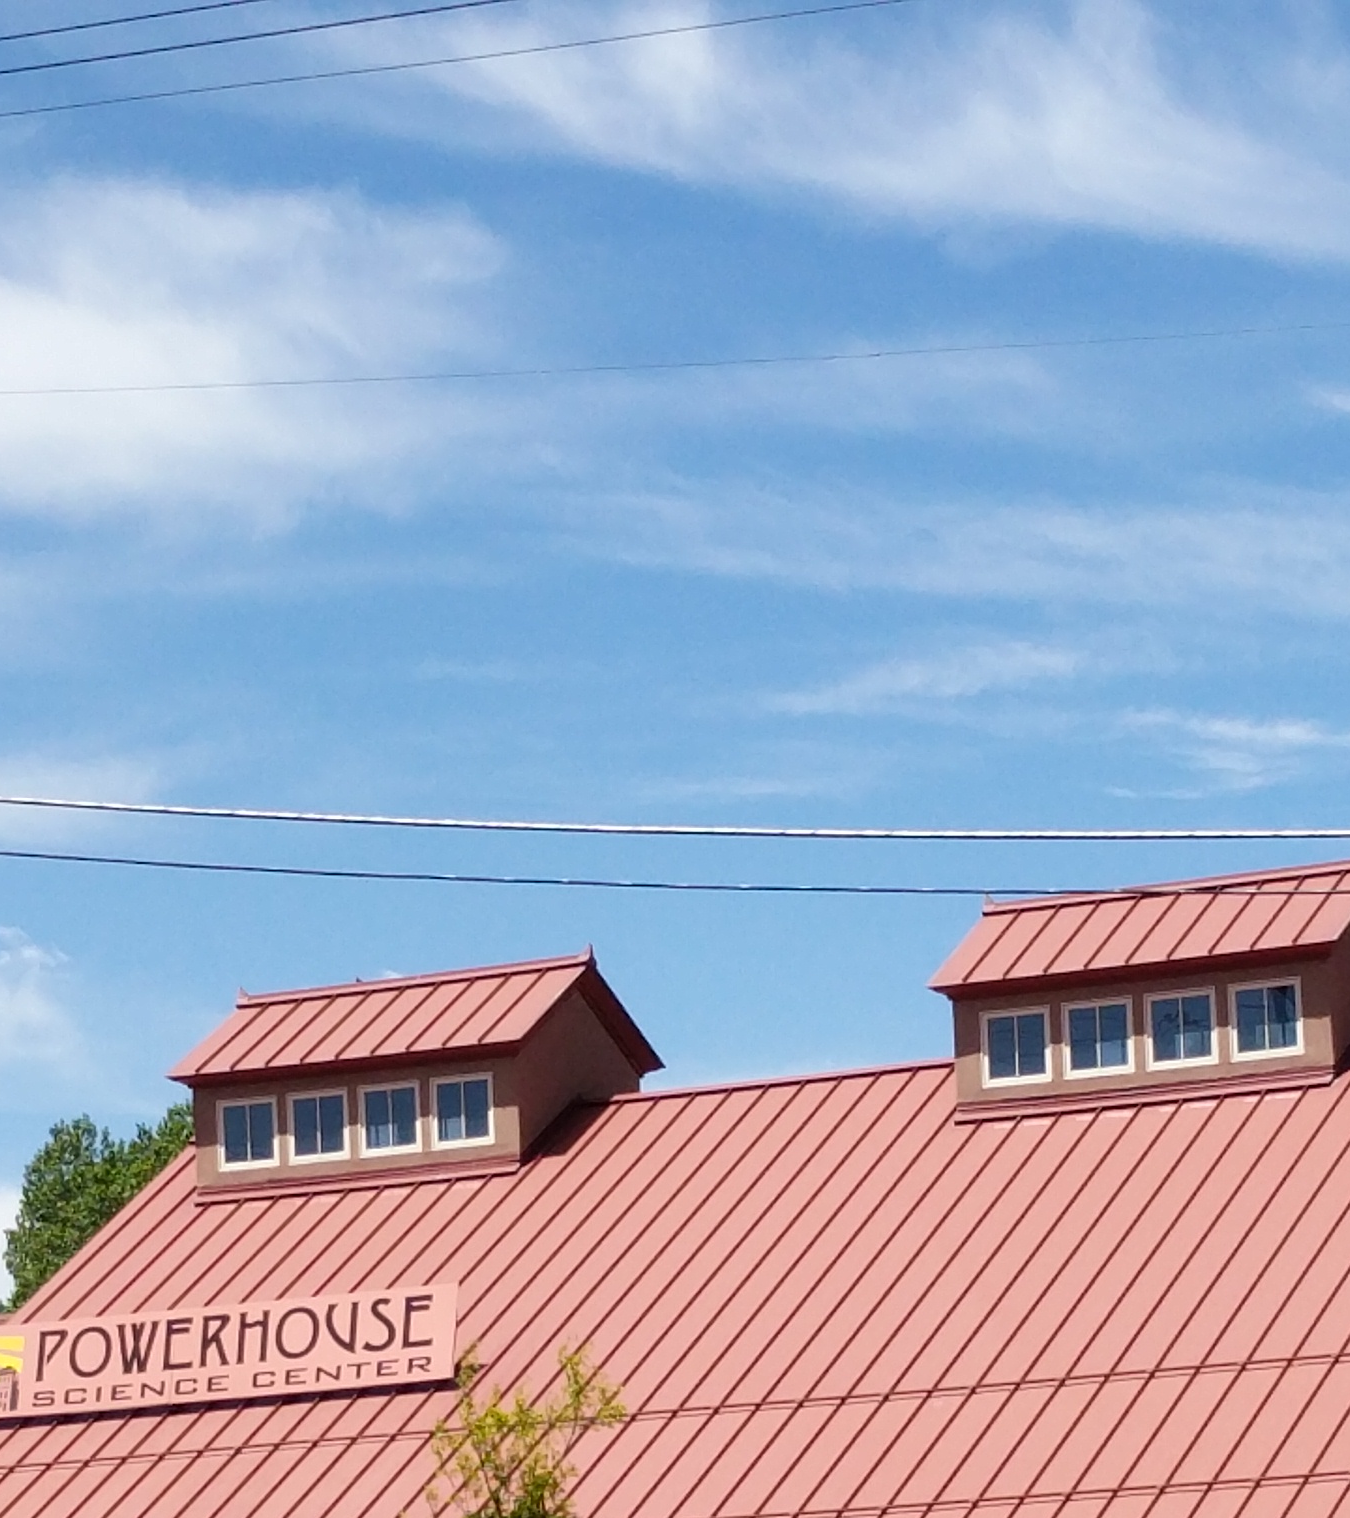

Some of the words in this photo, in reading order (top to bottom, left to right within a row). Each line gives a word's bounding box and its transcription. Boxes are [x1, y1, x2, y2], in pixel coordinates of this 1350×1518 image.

[35, 1294, 434, 1382] POWERHOUSE
[32, 1374, 229, 1407] SCIENCE
[251, 1356, 432, 1388] CENTER
